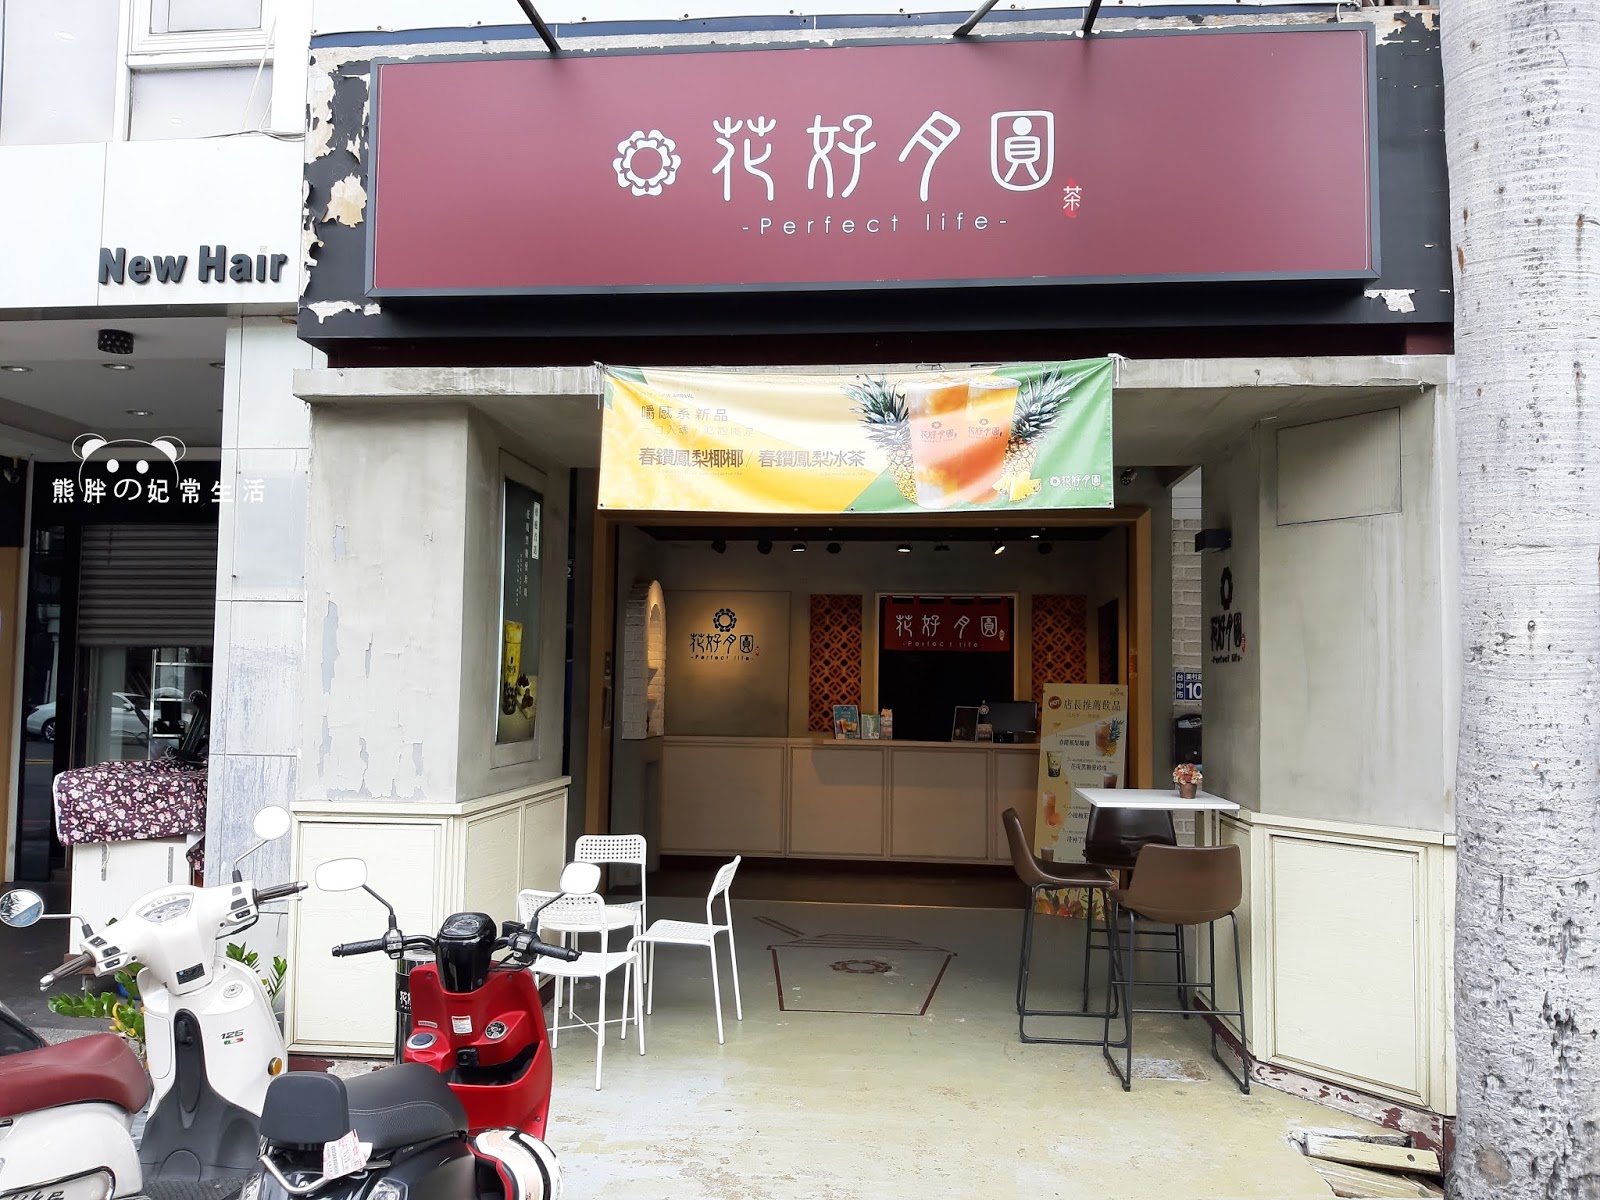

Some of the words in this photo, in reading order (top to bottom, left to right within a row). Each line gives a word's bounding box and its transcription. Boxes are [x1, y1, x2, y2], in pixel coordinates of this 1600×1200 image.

[711, 109, 1056, 202] 花好月圓
[1062, 184, 1083, 213] 茶
[98, 246, 188, 285] New
[198, 244, 288, 284] Hair
[641, 404, 728, 422] 嚼感系新品
[1176, 673, 1184, 699] 台中市
[220, 1029, 244, 1039] 125
